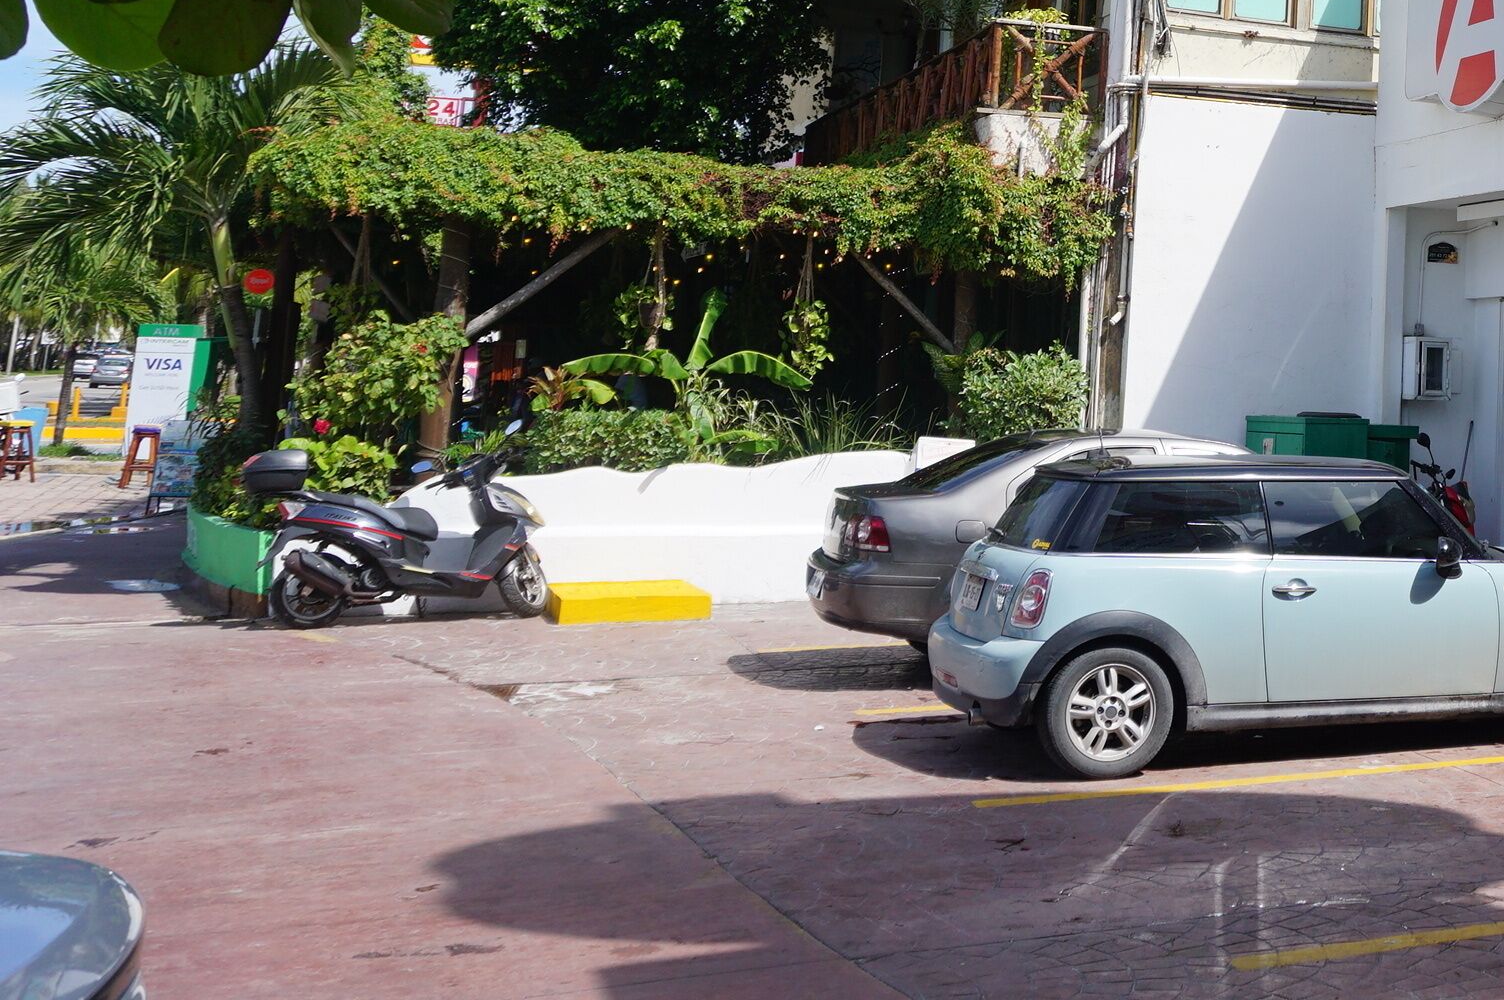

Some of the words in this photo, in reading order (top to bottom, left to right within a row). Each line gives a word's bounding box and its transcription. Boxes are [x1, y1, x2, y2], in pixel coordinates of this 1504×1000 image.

[426, 99, 455, 116] 24
[153, 327, 180, 336] ATM
[144, 358, 182, 370] VISA
